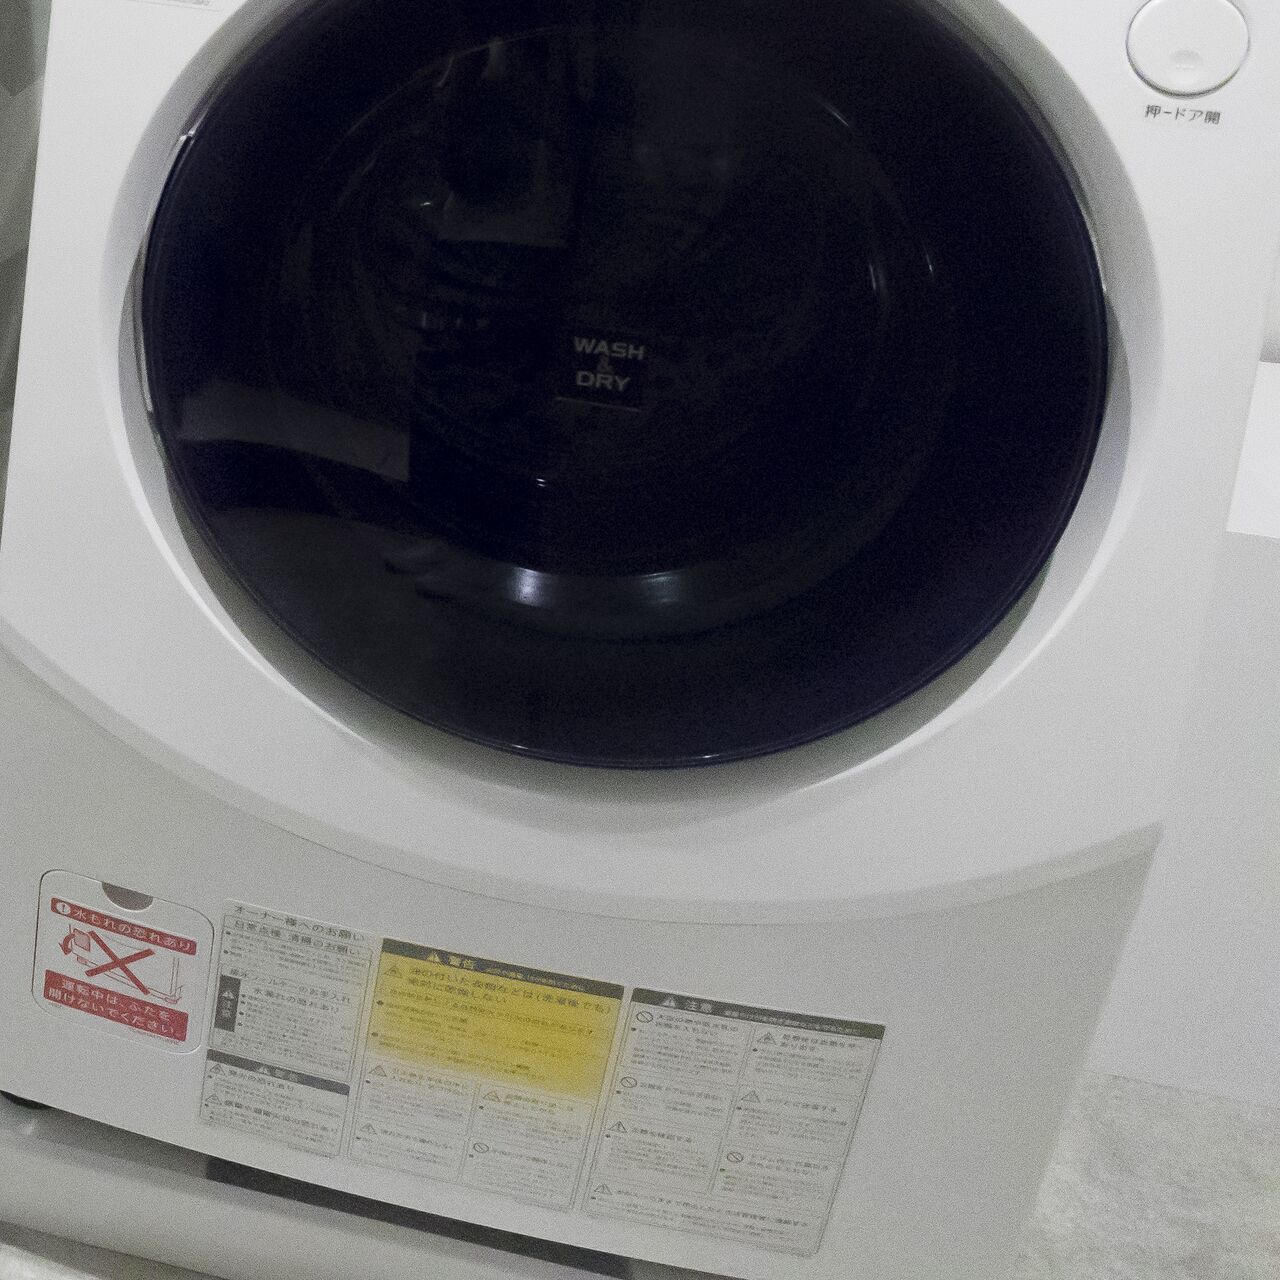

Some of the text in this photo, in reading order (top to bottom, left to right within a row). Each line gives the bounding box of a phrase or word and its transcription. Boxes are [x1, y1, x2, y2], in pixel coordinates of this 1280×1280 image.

[573, 335, 645, 361] WASH
[575, 370, 632, 392] DRY
[72, 908, 192, 952] 水もれの恐れあり
[61, 977, 171, 1021] 運転中は、ふたを
